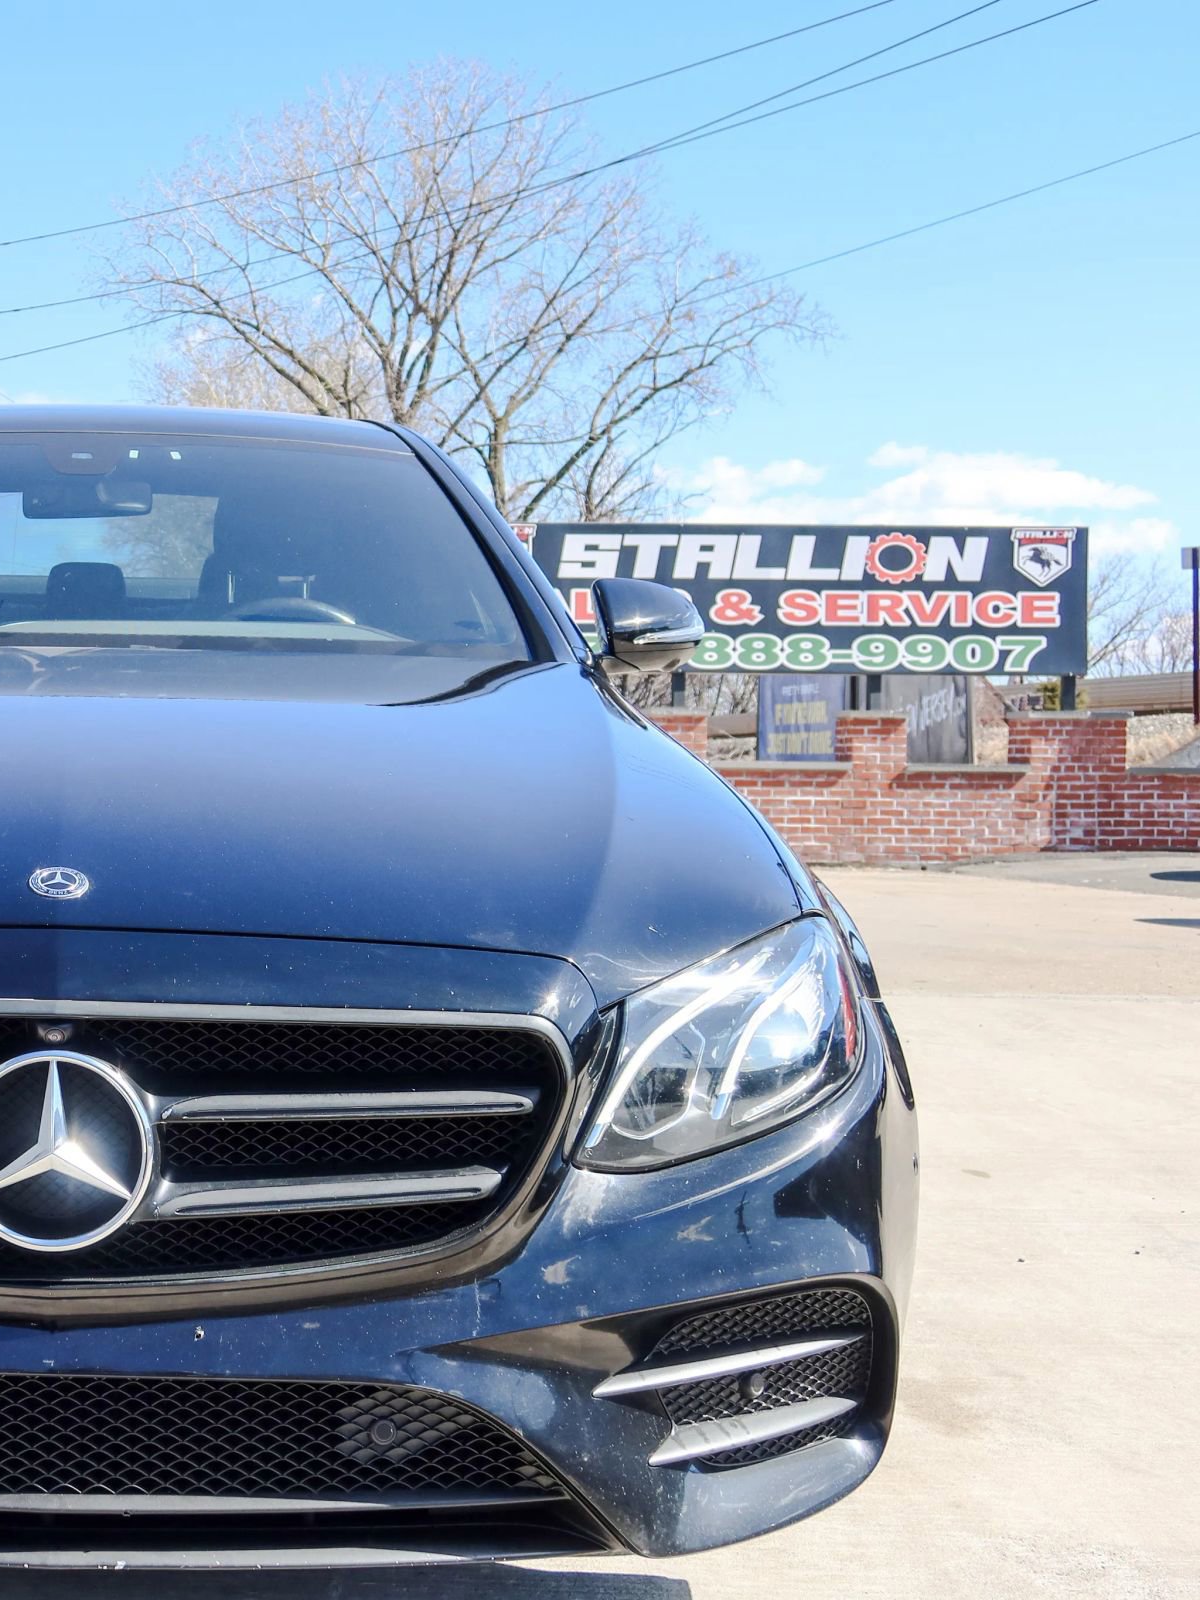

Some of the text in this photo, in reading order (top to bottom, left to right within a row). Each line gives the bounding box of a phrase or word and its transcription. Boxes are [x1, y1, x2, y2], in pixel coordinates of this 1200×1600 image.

[558, 533, 990, 583] STALLION
[710, 589, 764, 625] &
[777, 589, 1061, 627] SERVICE
